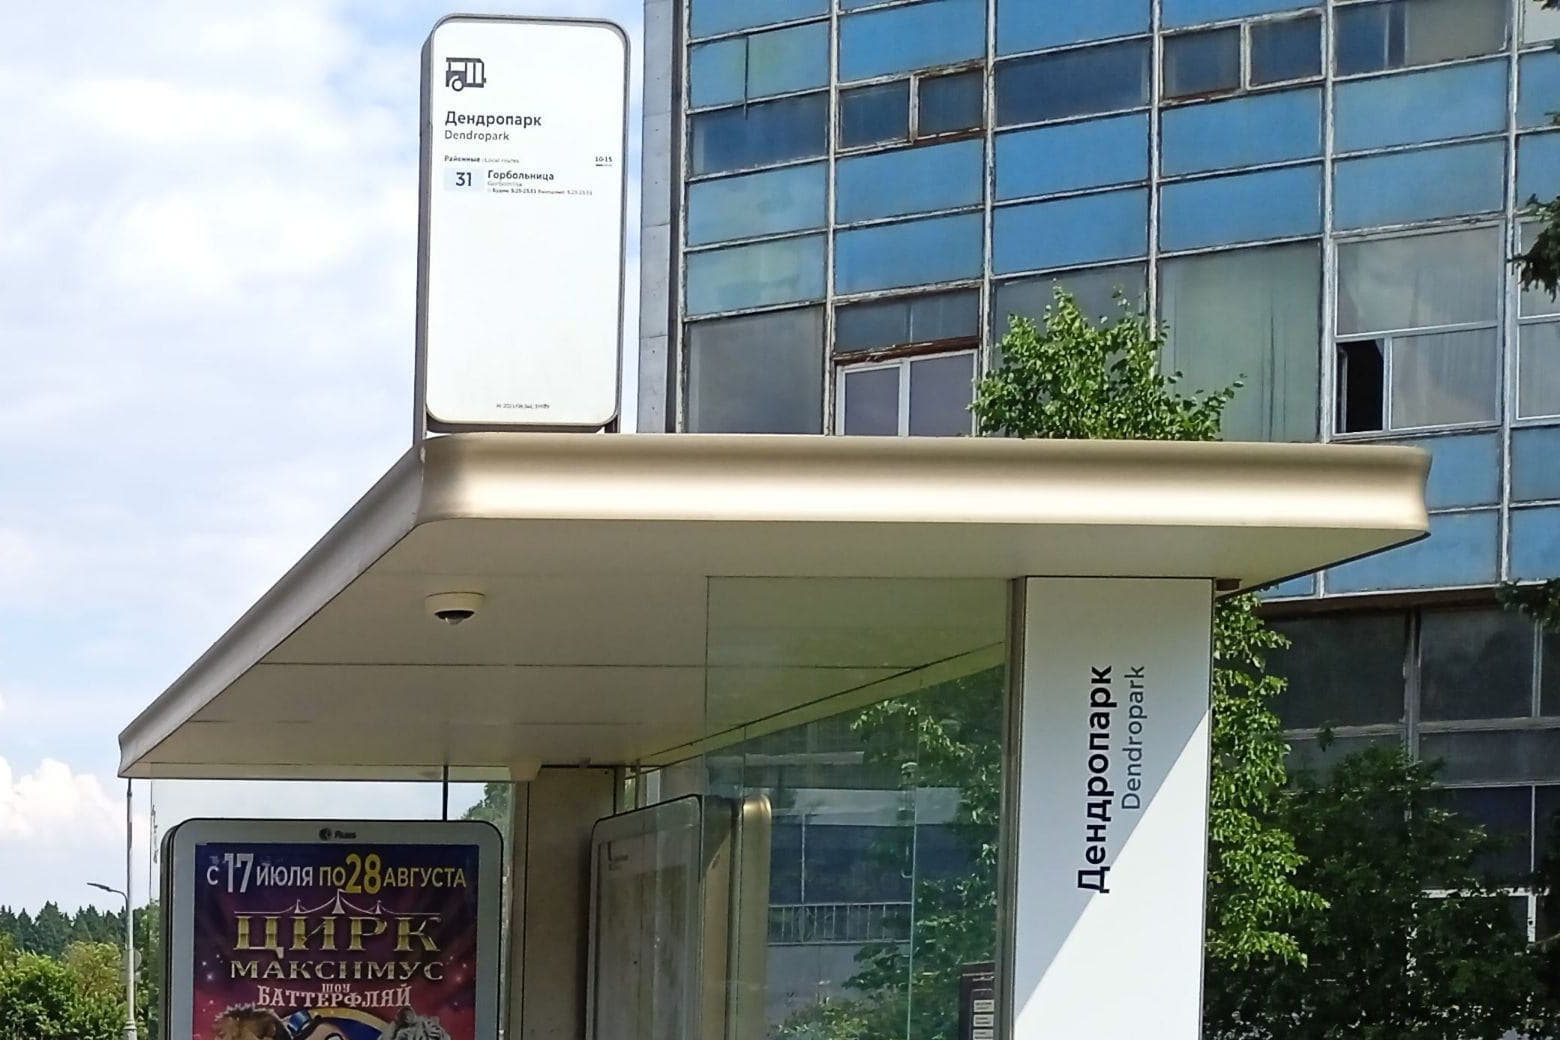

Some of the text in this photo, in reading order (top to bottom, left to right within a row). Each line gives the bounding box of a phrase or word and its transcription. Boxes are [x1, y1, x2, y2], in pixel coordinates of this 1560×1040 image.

[444, 110, 542, 128] Дендропарк
[444, 129, 510, 142] Dendropark
[455, 171, 472, 187] 31
[487, 169, 554, 182] Горбольница
[1121, 665, 1148, 810] Dendropark
[1077, 665, 1117, 894] Дендропарк
[223, 852, 254, 893] 17
[319, 866, 346, 887] ПО
[345, 853, 381, 894] 28
[383, 866, 467, 888] АВГУСТА
[233, 915, 441, 959] ЦИРК
[230, 959, 444, 981] МАКСИМУС
[256, 982, 412, 1008] БАТТЕРФЛЯЙ
[321, 982, 351, 994] ШОУ
